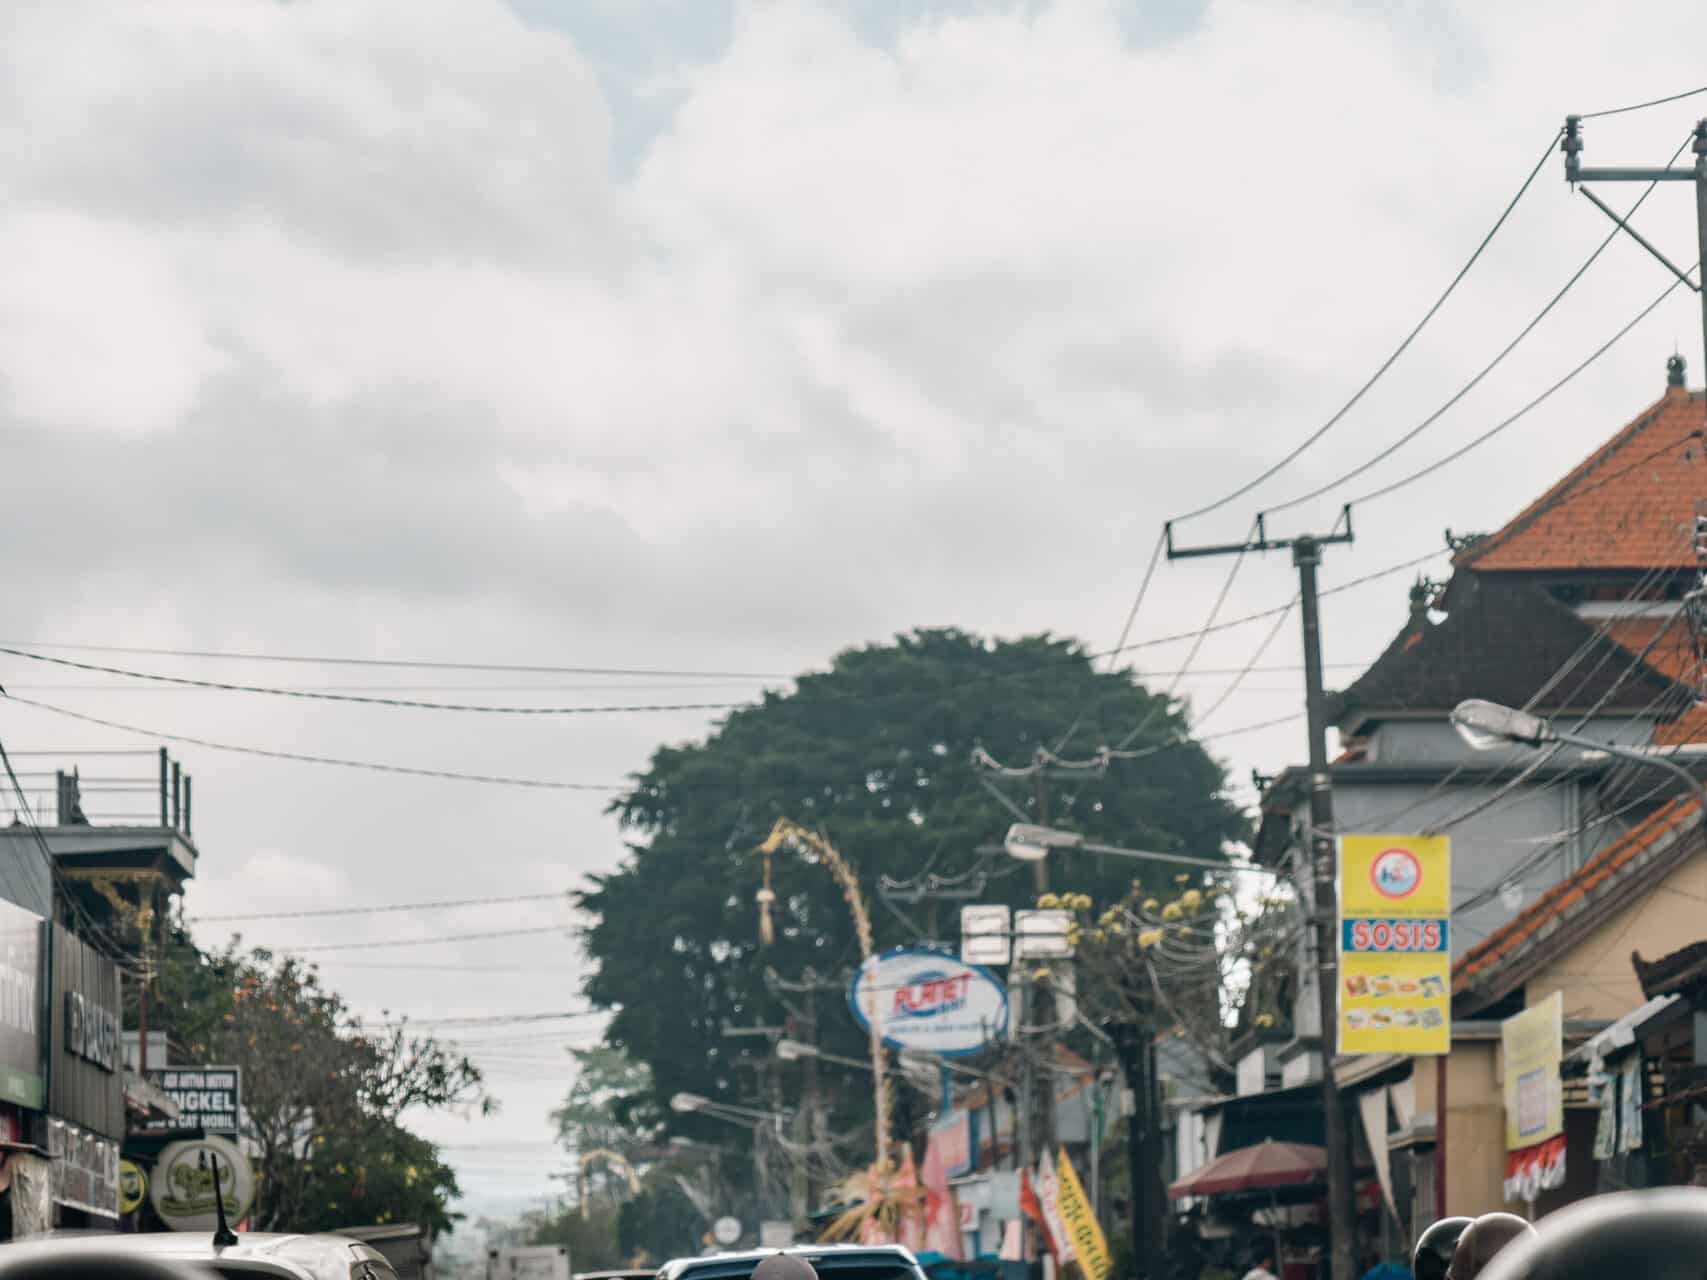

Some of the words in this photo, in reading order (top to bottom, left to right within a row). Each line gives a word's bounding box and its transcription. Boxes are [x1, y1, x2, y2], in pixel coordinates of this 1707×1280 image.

[1353, 921, 1440, 949] SOSIS
[166, 1090, 235, 1111] NGKEL
[201, 1113, 235, 1129] MOBIL
